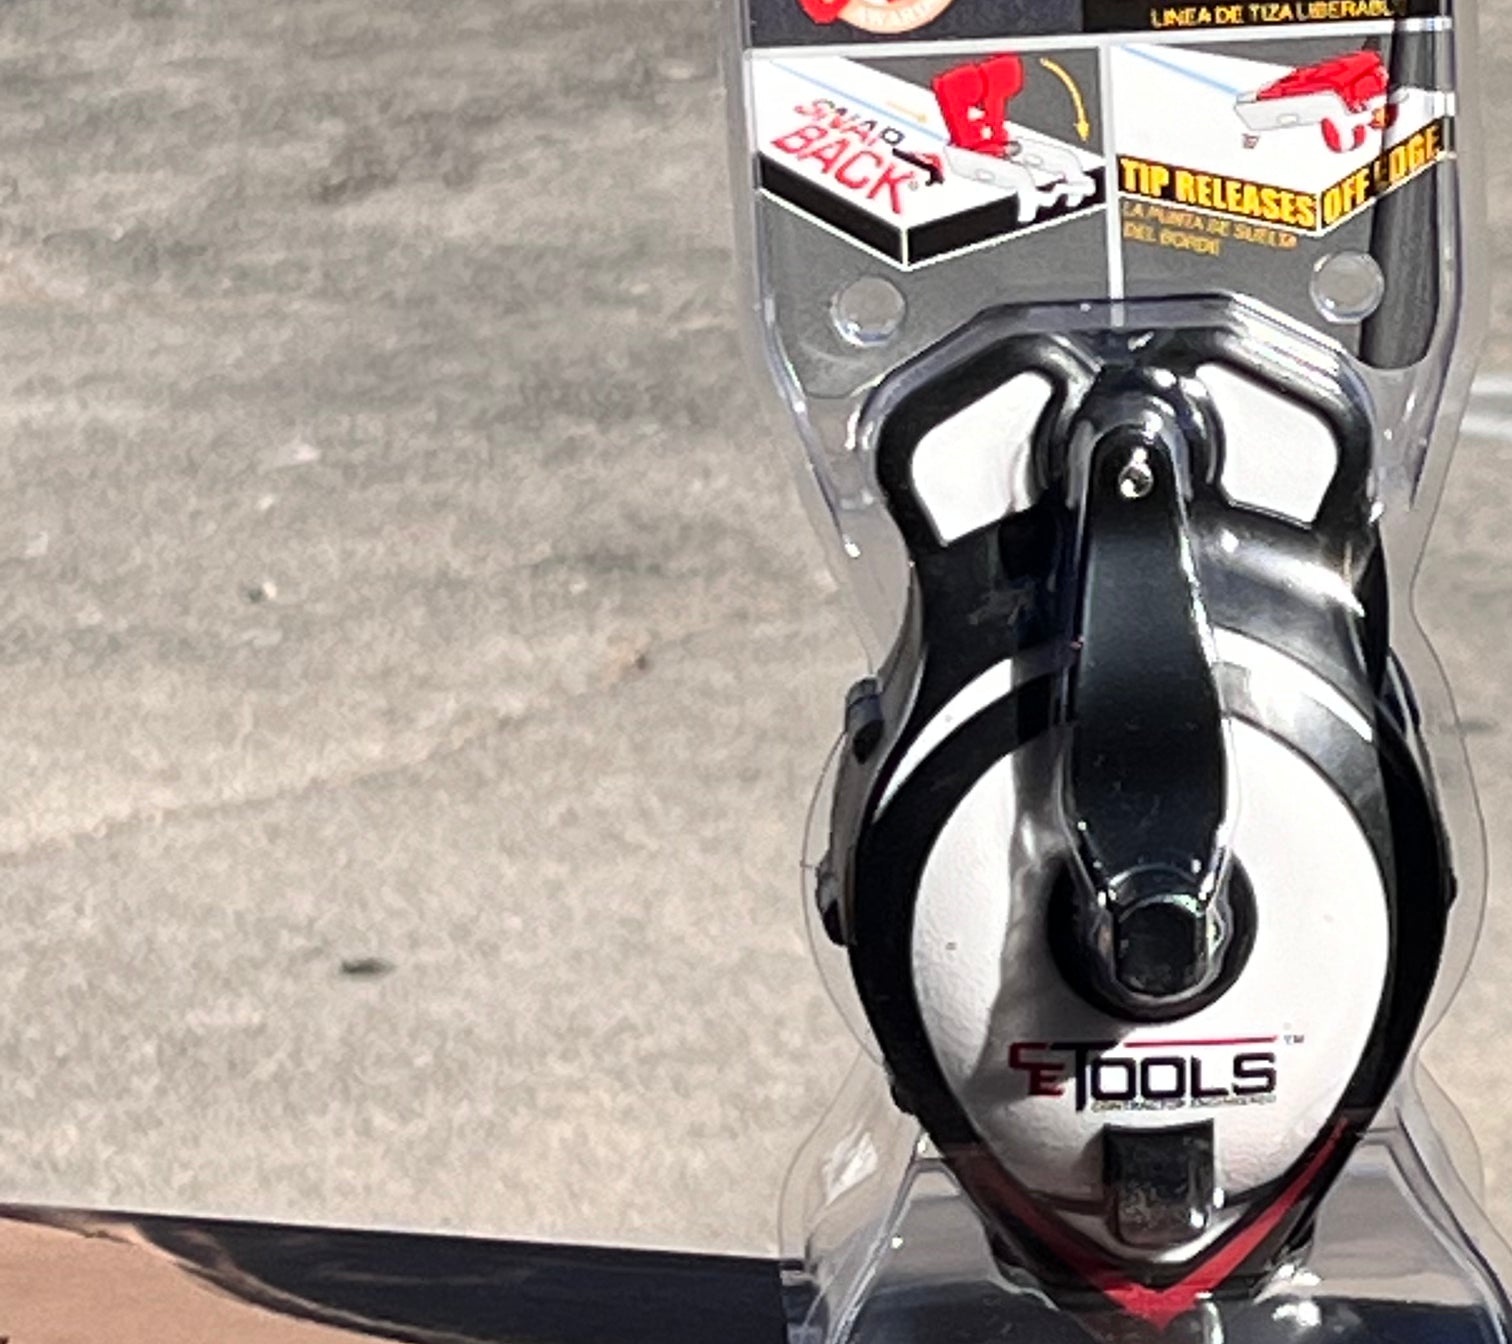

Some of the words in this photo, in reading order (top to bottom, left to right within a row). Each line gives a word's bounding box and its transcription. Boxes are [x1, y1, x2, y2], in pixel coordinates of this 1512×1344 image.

[1215, 6, 1245, 25] DE
[1250, 3, 1294, 22] TIZA
[770, 125, 916, 215] BACK
[1120, 158, 1170, 197] TIP
[1175, 170, 1316, 228] RELEASES
[1323, 168, 1370, 225] OFF
